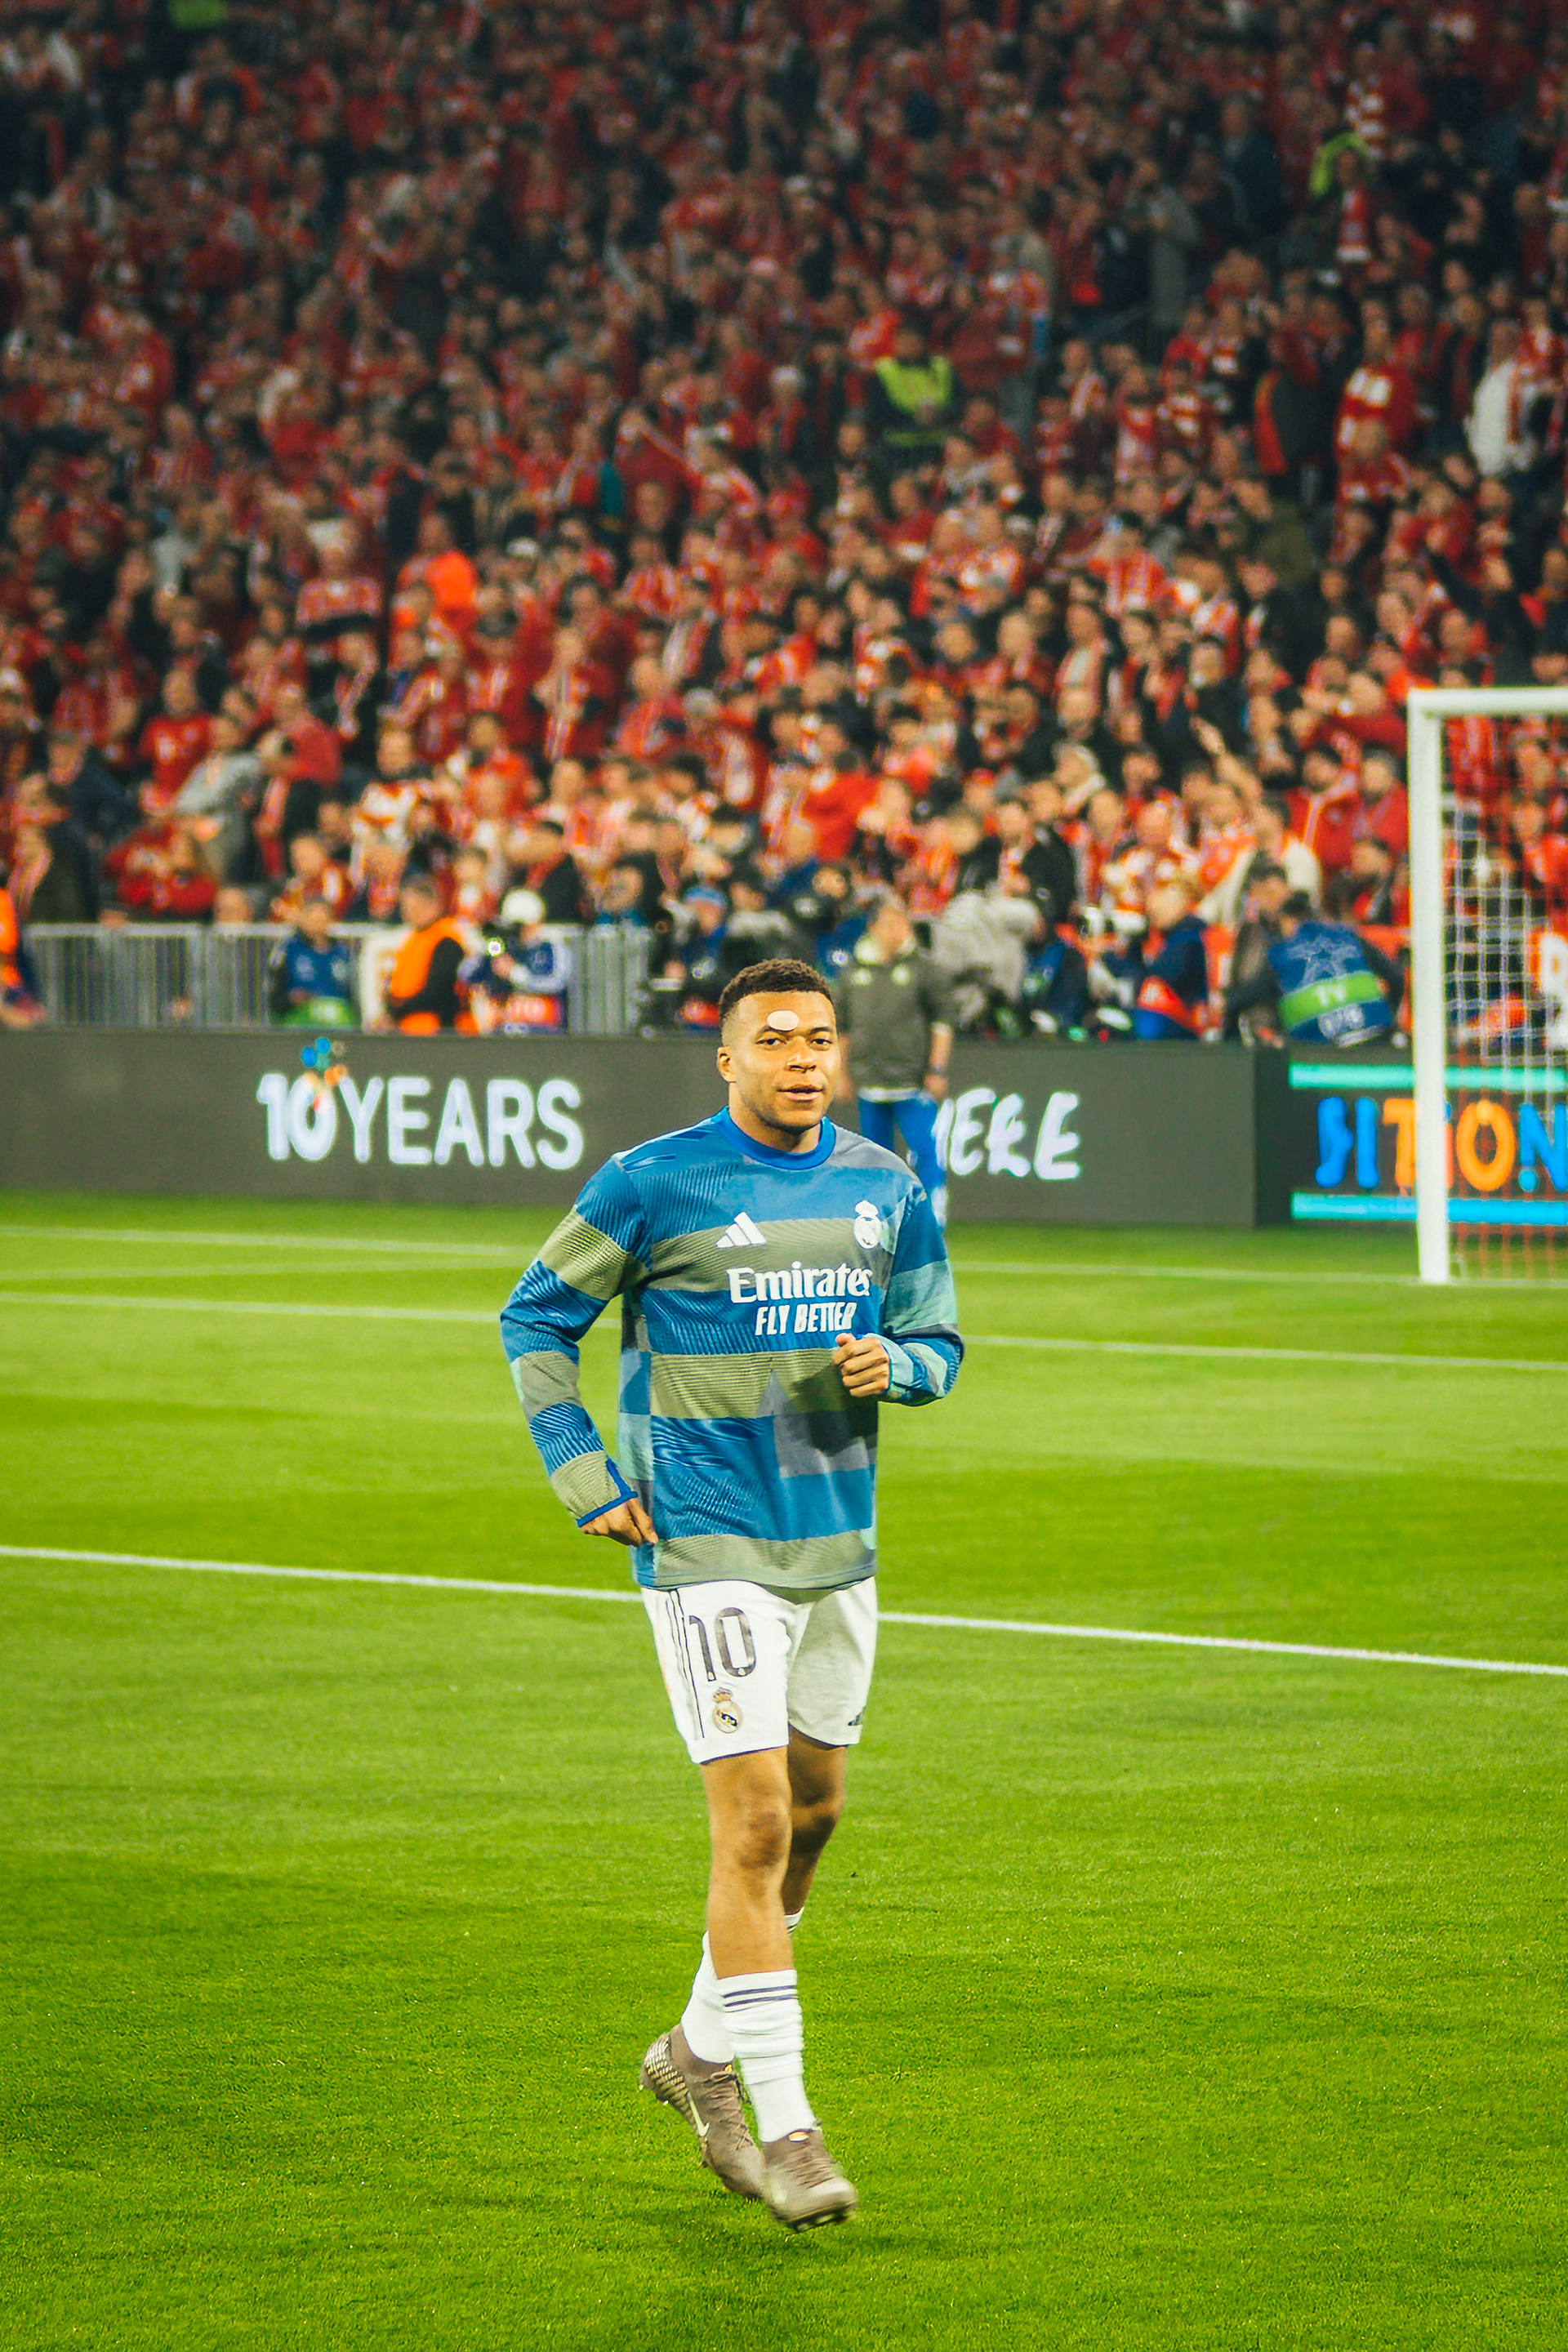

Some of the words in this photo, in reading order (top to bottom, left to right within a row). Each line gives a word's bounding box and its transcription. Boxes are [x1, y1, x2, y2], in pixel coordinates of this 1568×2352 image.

[726, 1260, 873, 1303] Emirates
[755, 1304, 790, 1335] FLY
[794, 1302, 857, 1334] BETTER
[688, 1606, 756, 1682] 10
